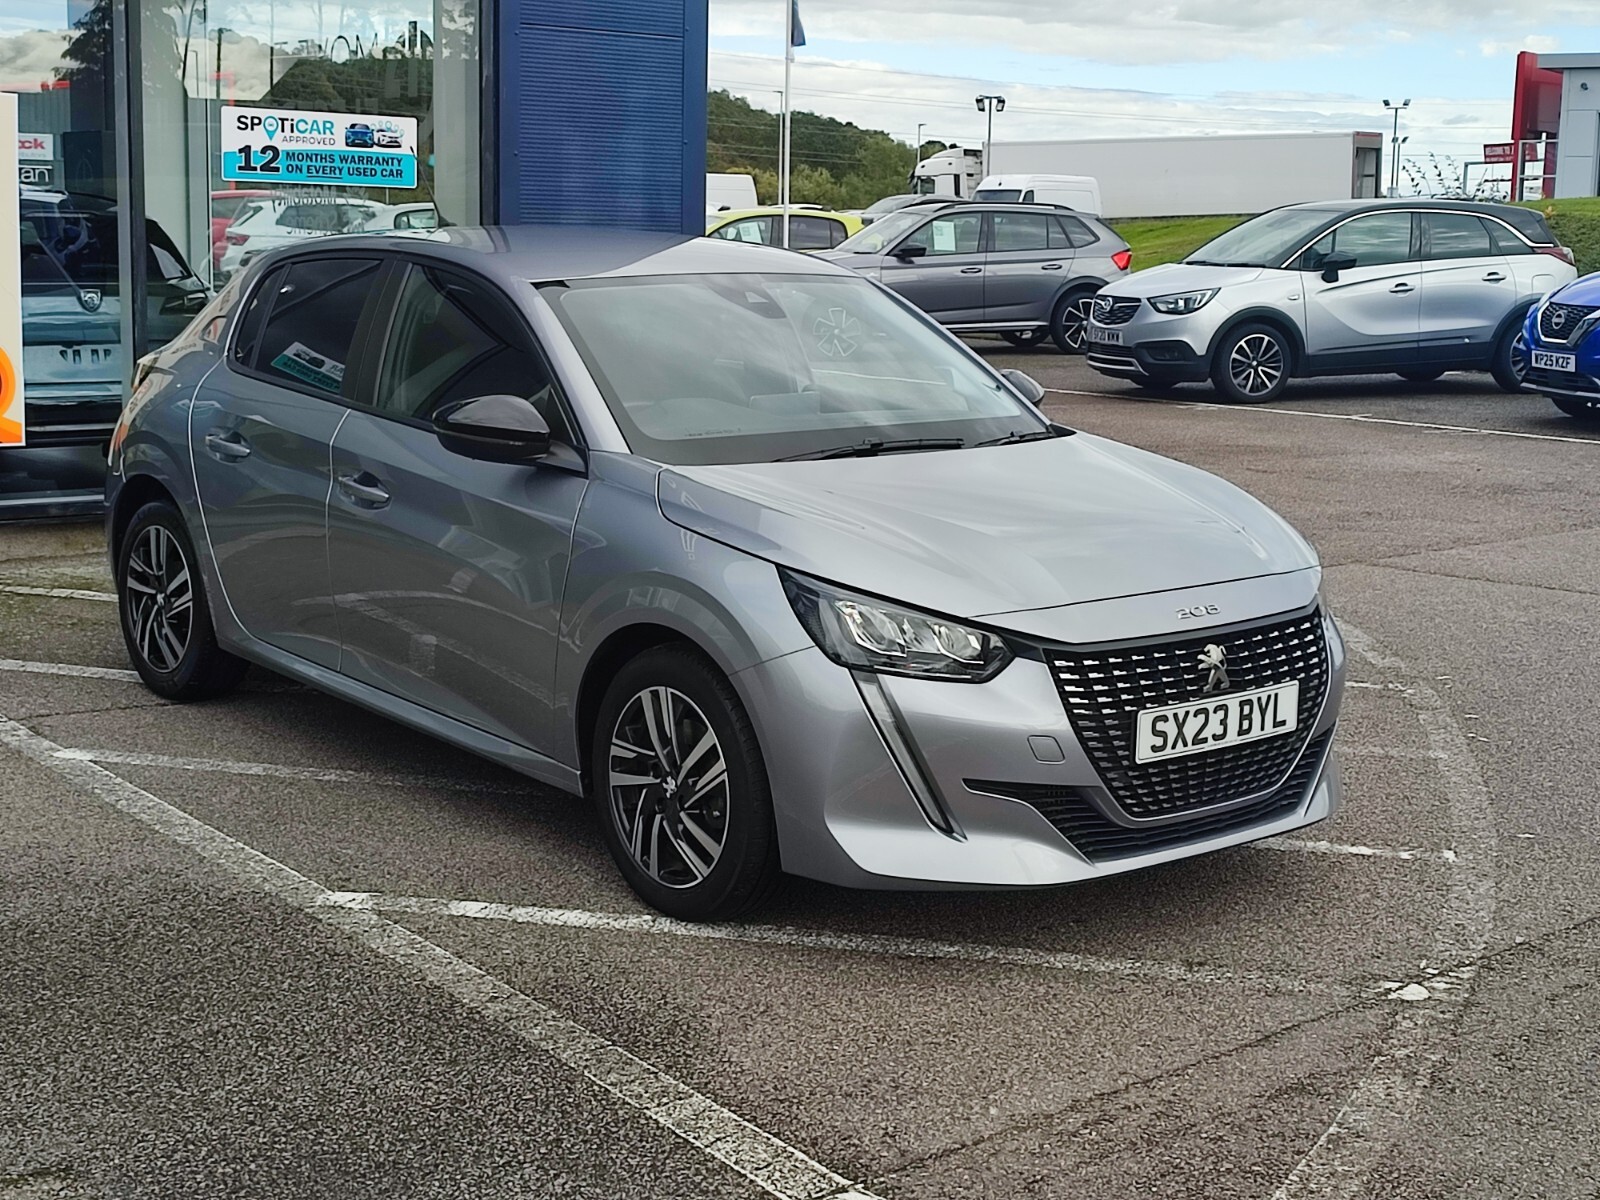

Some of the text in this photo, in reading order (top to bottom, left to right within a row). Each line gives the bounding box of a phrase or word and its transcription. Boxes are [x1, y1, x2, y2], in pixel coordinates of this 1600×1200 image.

[281, 135, 336, 146] APPROVED
[237, 145, 281, 173] 12
[285, 152, 403, 167] MONTHS WARRANTY
[286, 163, 403, 179] ON EVERY USED CAR
[1534, 352, 1571, 369] WP25 KZF
[1175, 603, 1221, 620] 208
[1150, 692, 1287, 753] SX23 BYL
